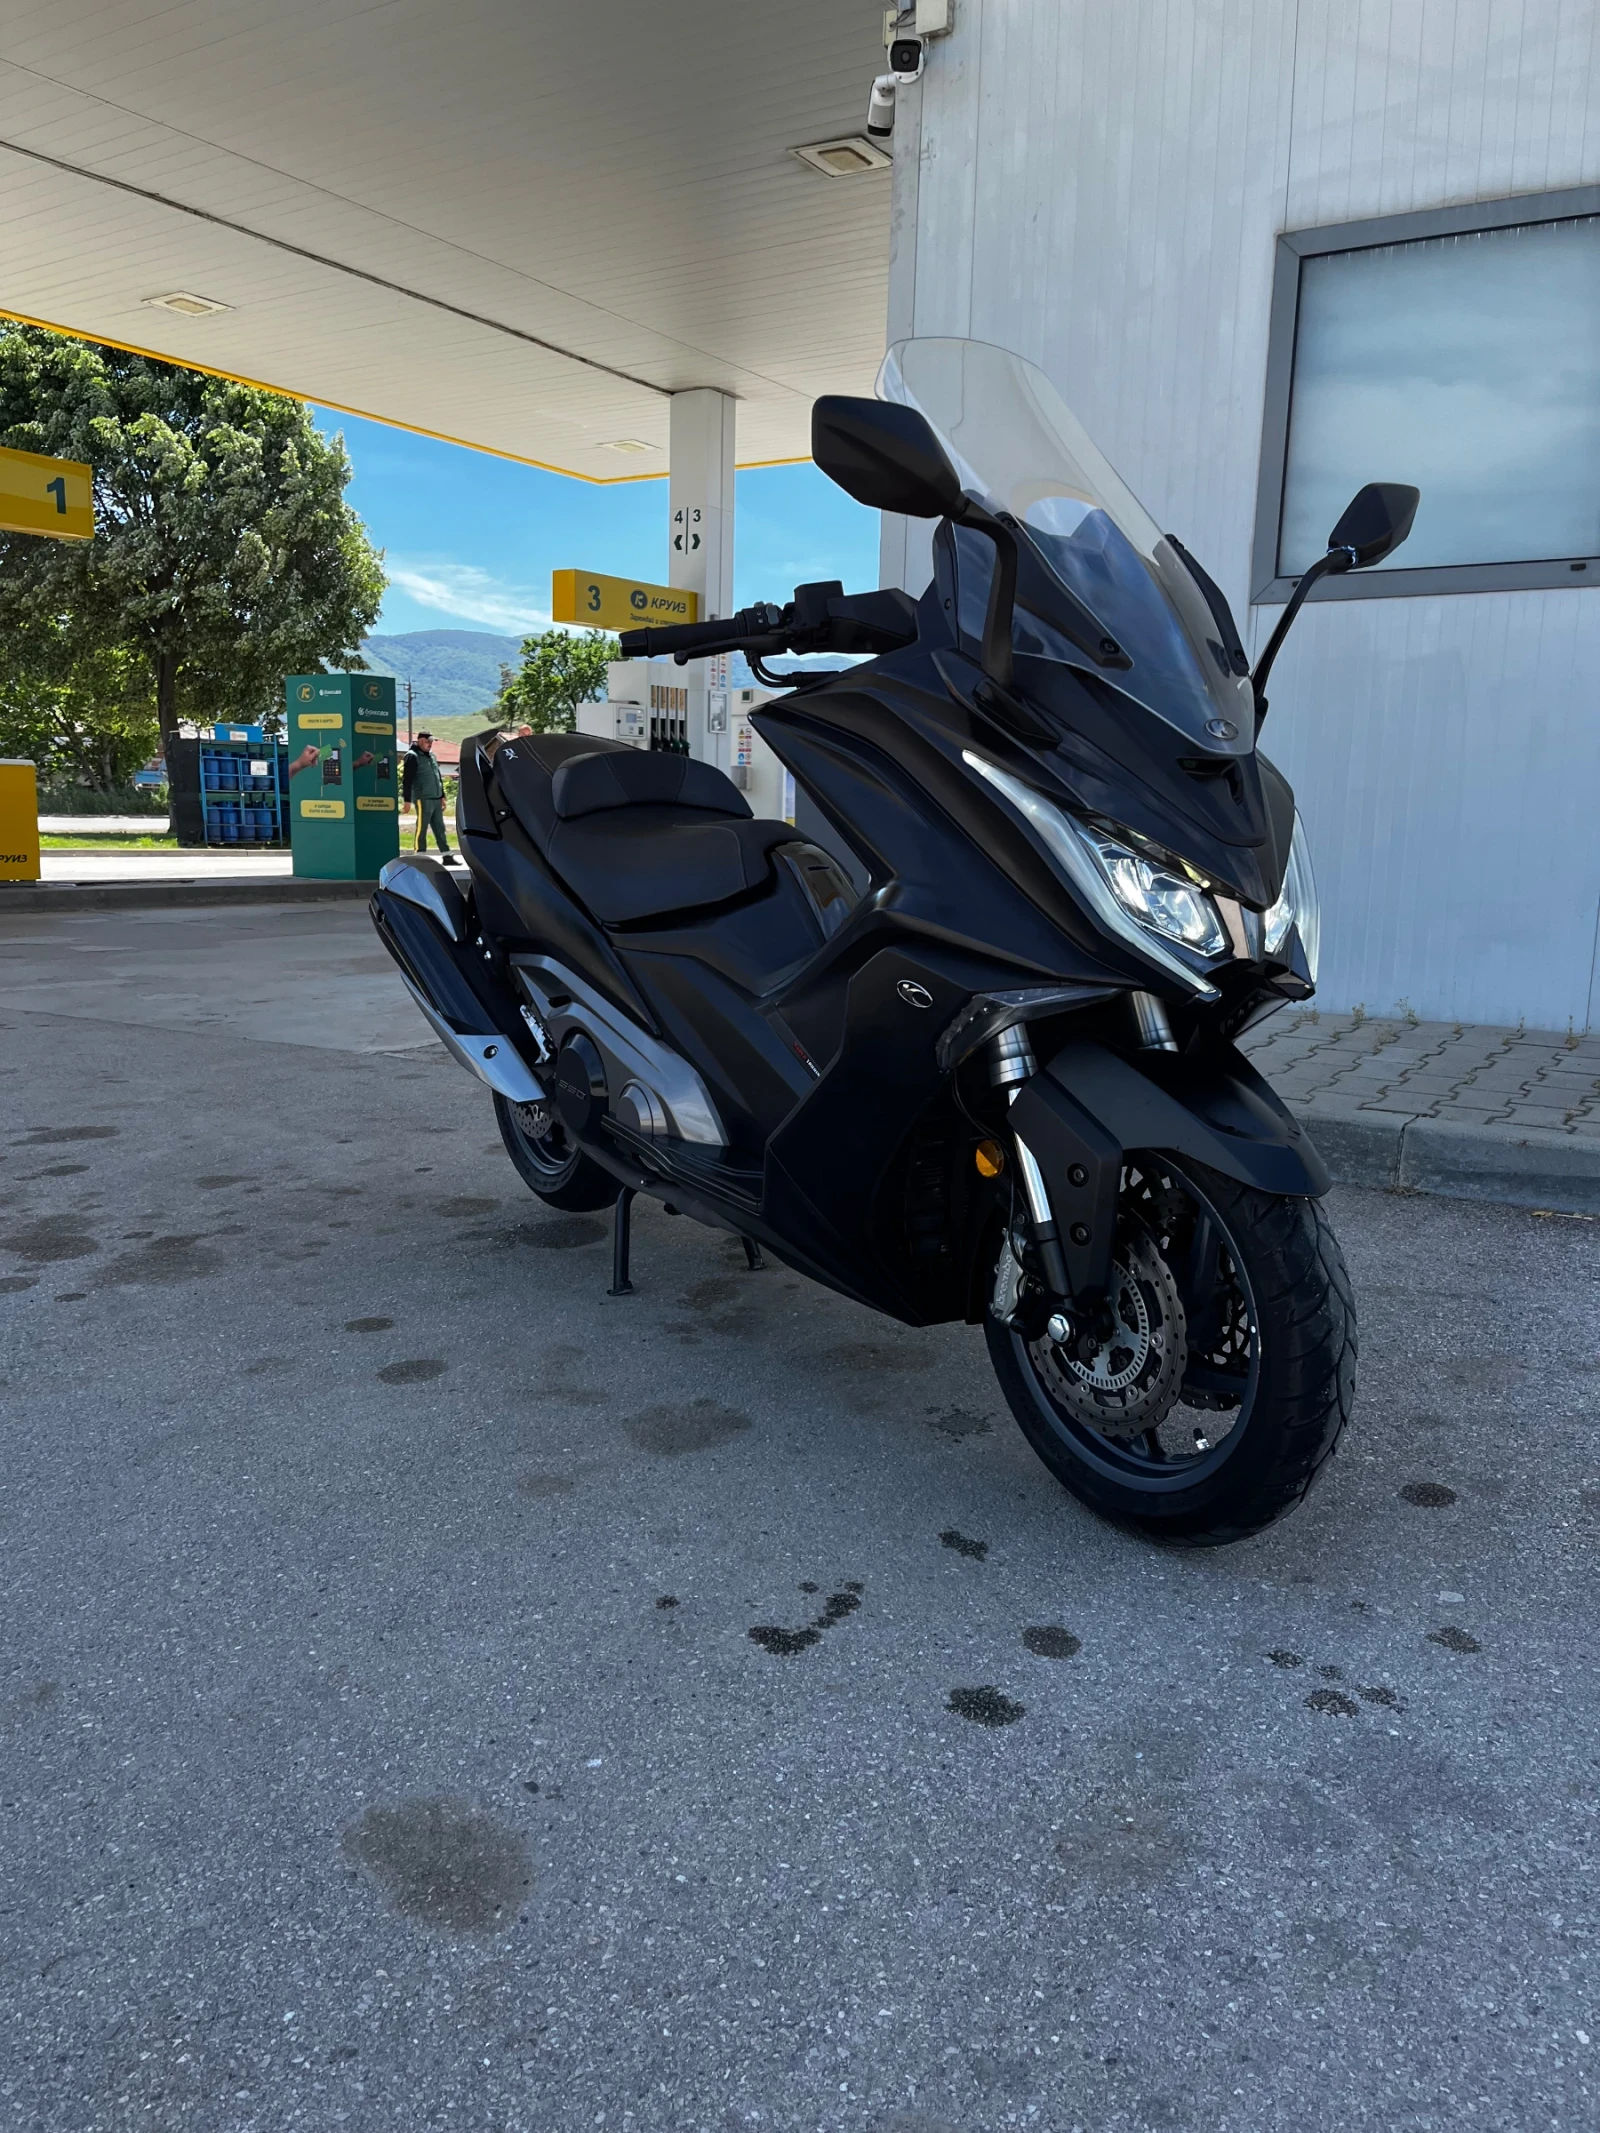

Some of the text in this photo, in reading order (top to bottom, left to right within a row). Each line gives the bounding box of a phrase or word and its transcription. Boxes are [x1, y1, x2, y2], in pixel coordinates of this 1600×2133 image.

[46, 476, 67, 515] 1
[674, 508, 701, 524] 4 3
[587, 584, 602, 612] 3
[650, 597, 687, 614] КРУИЗ
[995, 1254, 1013, 1306] brembo
